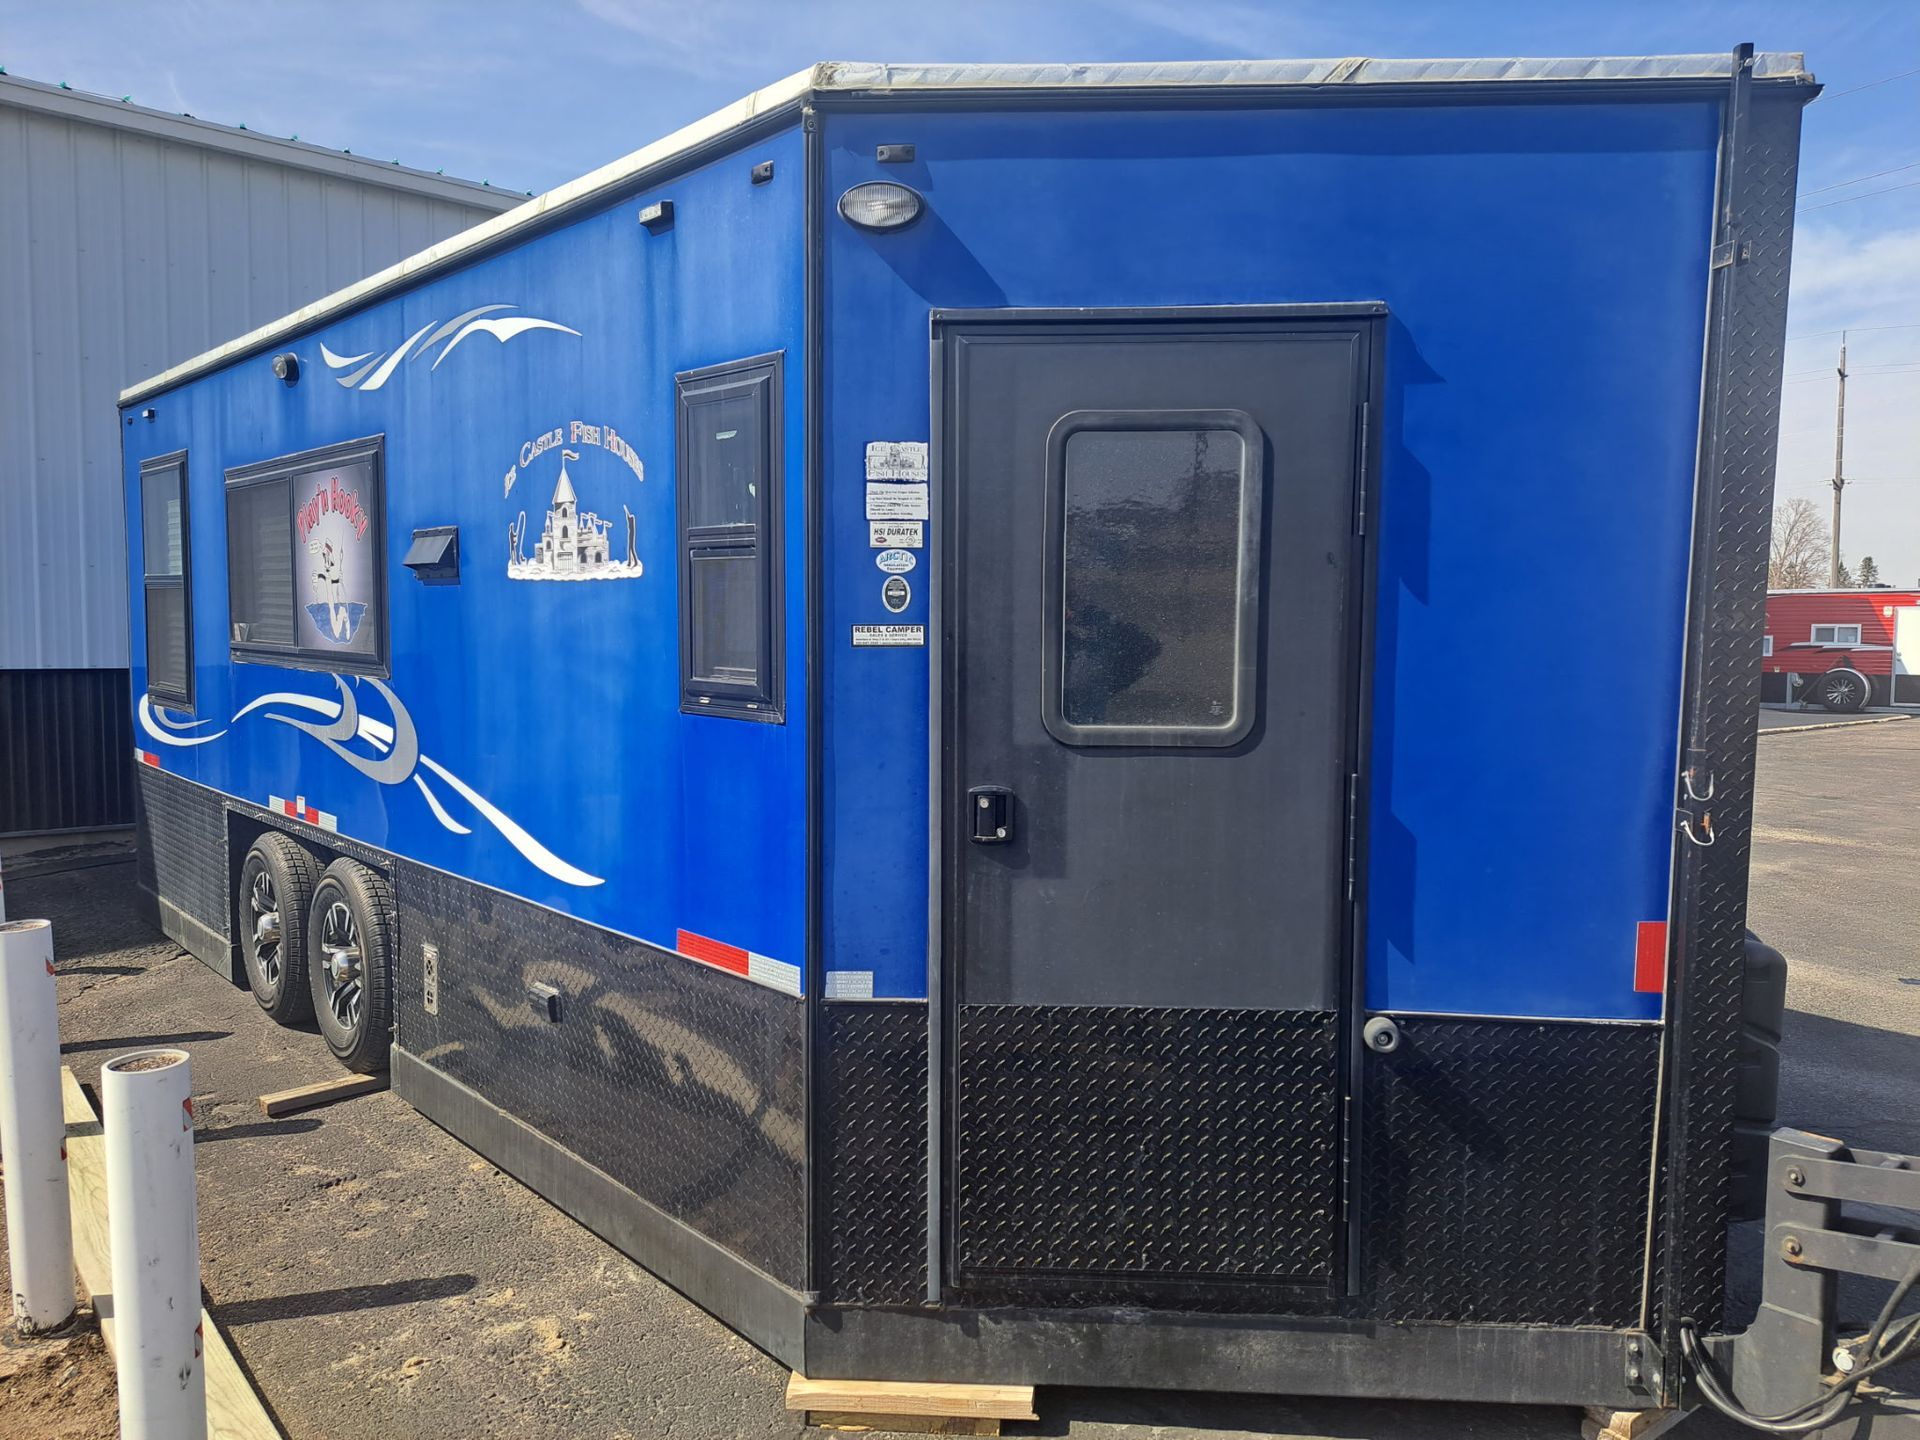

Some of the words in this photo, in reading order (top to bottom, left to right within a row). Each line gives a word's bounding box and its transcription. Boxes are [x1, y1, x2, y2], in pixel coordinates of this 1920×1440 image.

[519, 428, 563, 468] CASTLE
[570, 421, 601, 446] FISH
[873, 527, 886, 536] HSI
[887, 528, 918, 536] DURATEK
